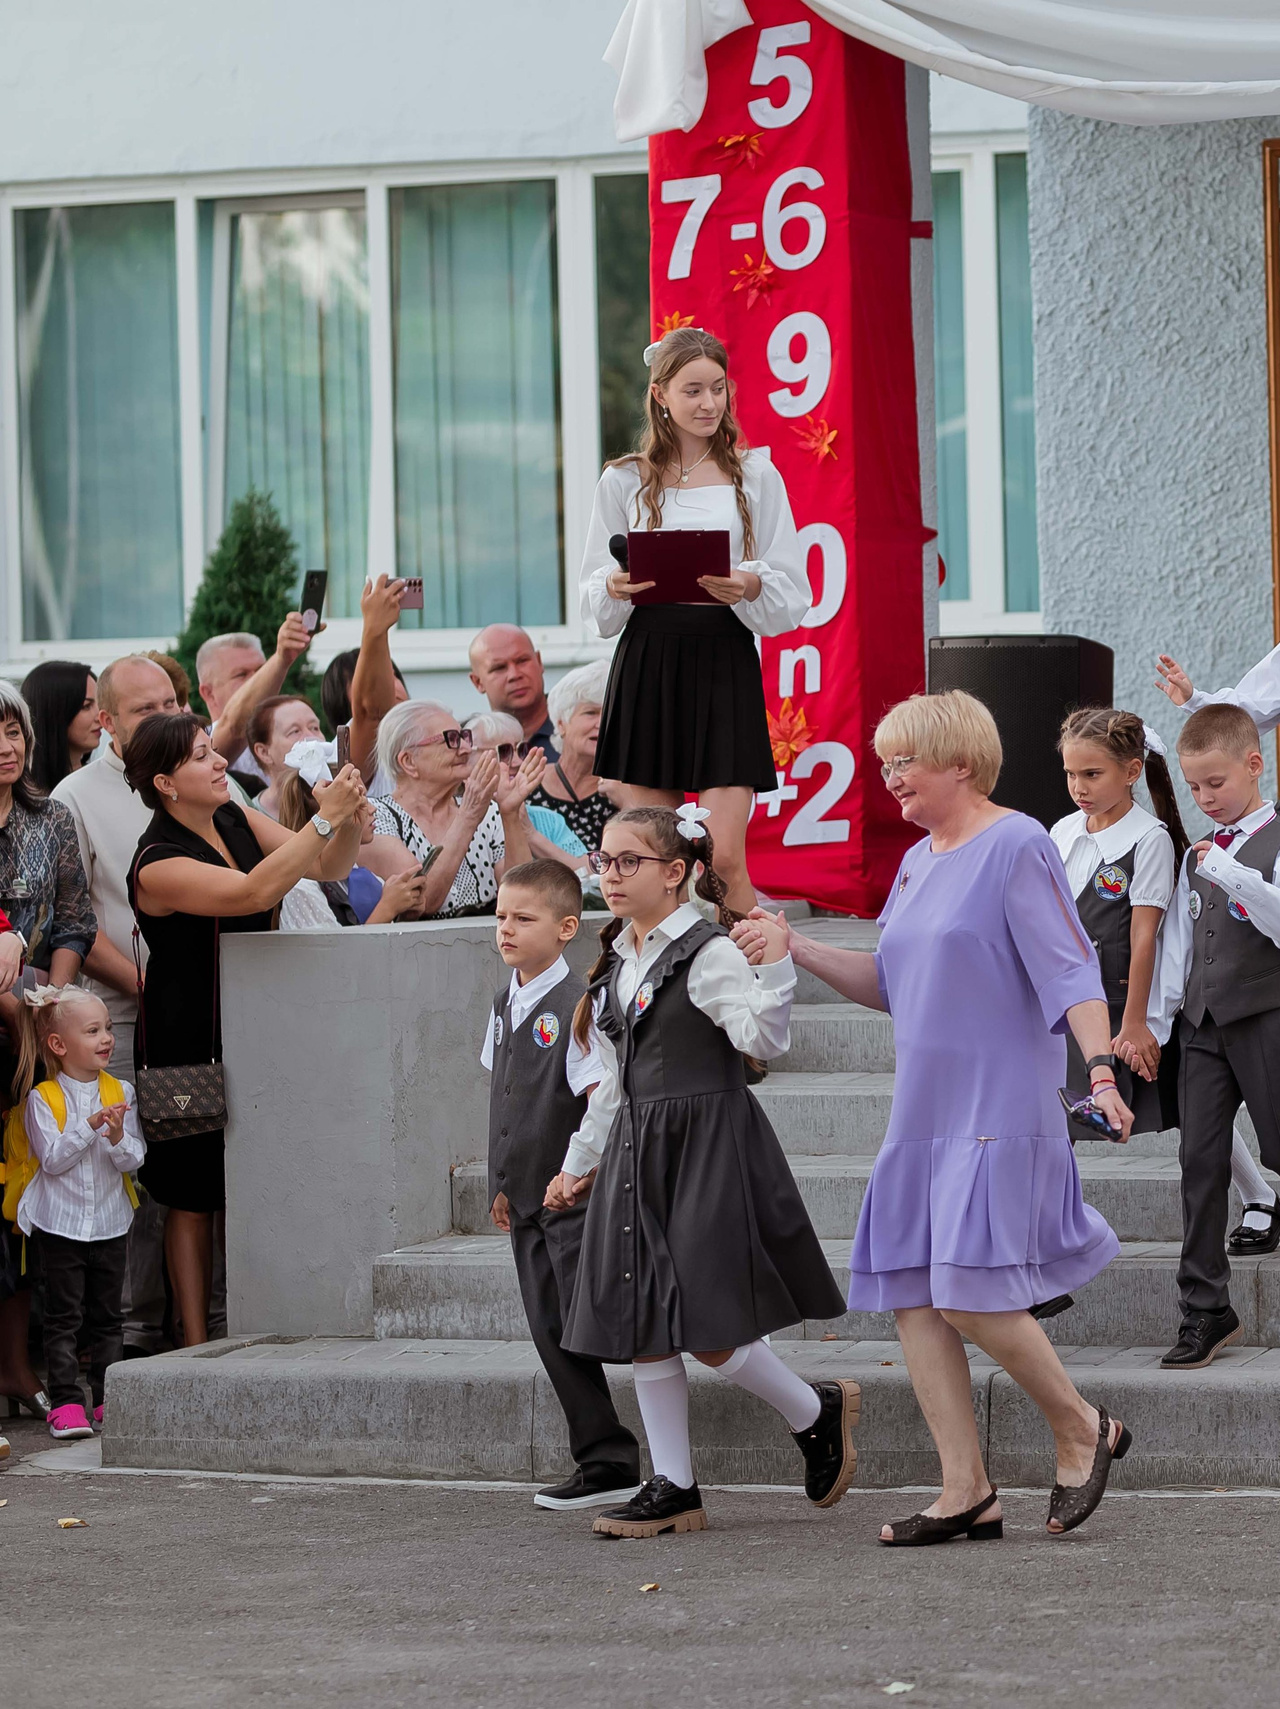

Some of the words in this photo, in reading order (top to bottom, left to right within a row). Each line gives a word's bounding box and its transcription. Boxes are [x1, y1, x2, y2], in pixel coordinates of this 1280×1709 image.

[747, 20, 813, 129] 5
[767, 311, 832, 418] 9
[747, 741, 855, 847] +2
